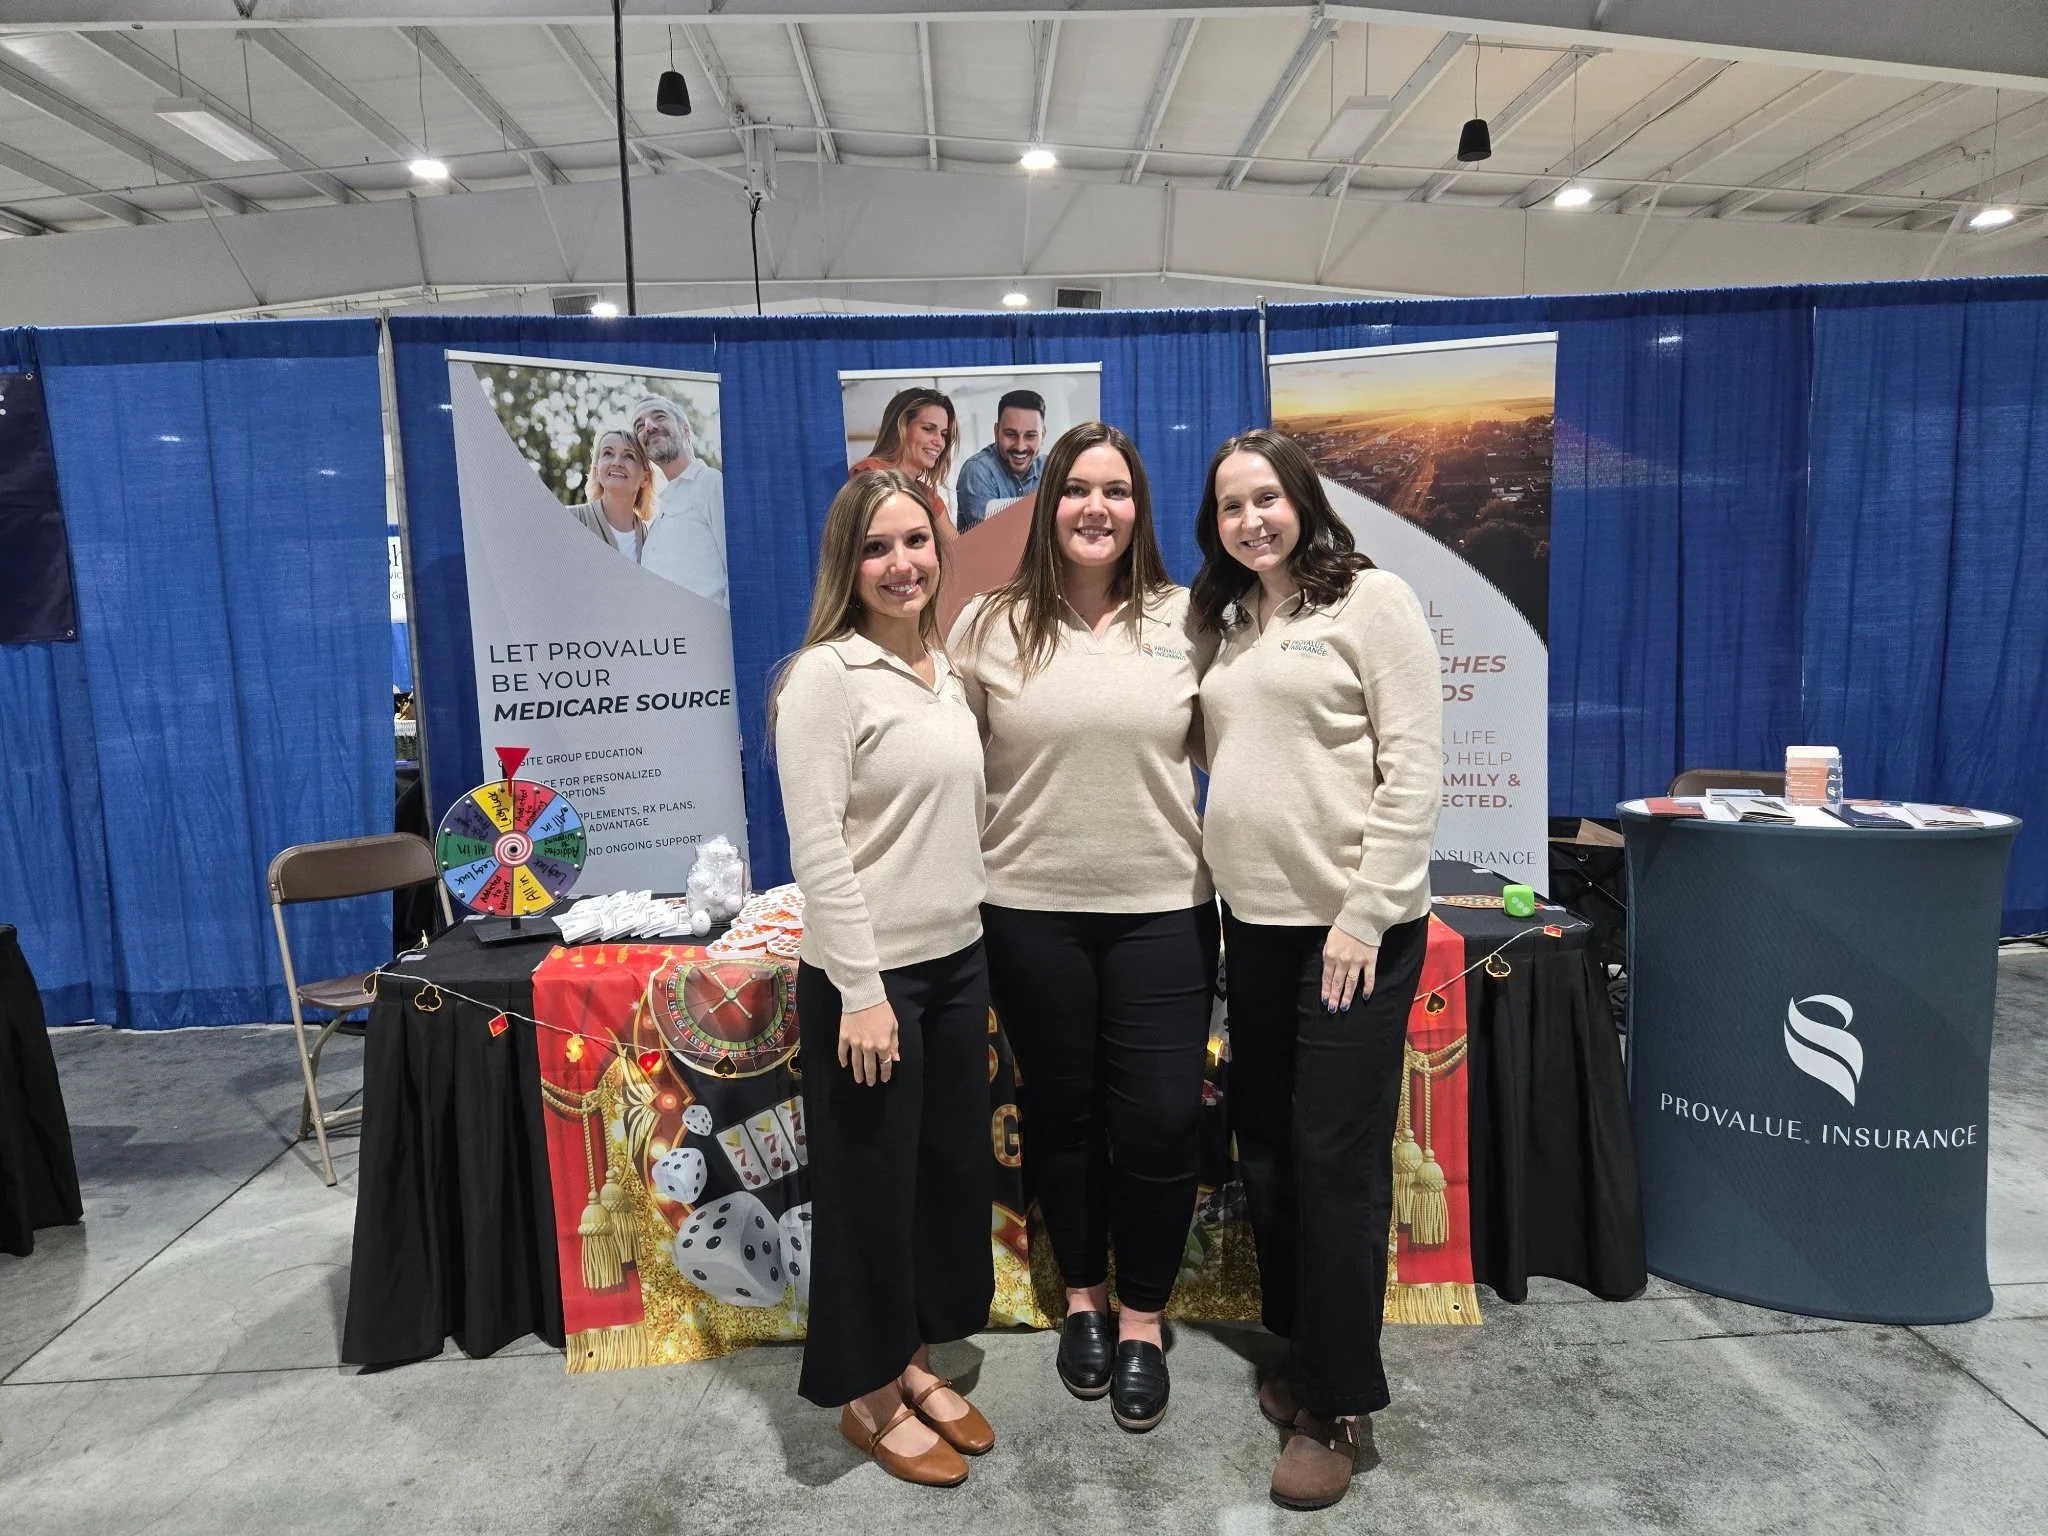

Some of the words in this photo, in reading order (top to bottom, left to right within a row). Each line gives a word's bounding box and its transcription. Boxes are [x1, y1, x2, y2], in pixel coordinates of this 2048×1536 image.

[489, 643, 539, 663] LET
[549, 637, 687, 660] PROVALUE
[1440, 655, 1507, 673] CHES
[492, 673, 529, 693] BE
[538, 669, 610, 690] YOUR
[1442, 684, 1475, 702] DS
[494, 695, 630, 721] MEDICARE
[636, 688, 731, 711] SOURCE
[1453, 731, 1496, 744] LIFE
[546, 753, 582, 764] GROUP
[585, 747, 643, 760] EDUCATION
[1458, 752, 1512, 766] HELP
[560, 776, 581, 788] FOR
[583, 768, 662, 785] PERSONALIZED
[1443, 773, 1500, 787] MILY
[1508, 773, 1521, 787] &
[562, 787, 606, 799] OPTIONS
[1442, 794, 1512, 808] ECTED.
[515, 789, 527, 822] Addicted
[579, 807, 640, 821] PPLEMENTS,
[642, 804, 656, 814] RX
[660, 801, 696, 812] PLANS,
[588, 818, 650, 833] ADVANTAGE
[457, 844, 471, 856] in
[474, 844, 487, 855] All
[544, 847, 579, 858] Addicted
[587, 846, 603, 858] ND
[605, 841, 653, 854] ONGOING
[655, 834, 702, 848] SUPPORT
[1431, 849, 1536, 865] NSURANCE
[480, 875, 502, 903] Addicted
[520, 874, 530, 888] in
[522, 886, 540, 901] All
[1661, 1092, 1802, 1141] PROVALUE
[1822, 1124, 1977, 1149] INSURANCE
[763, 1133, 777, 1154] 7
[734, 1148, 747, 1167] 7
